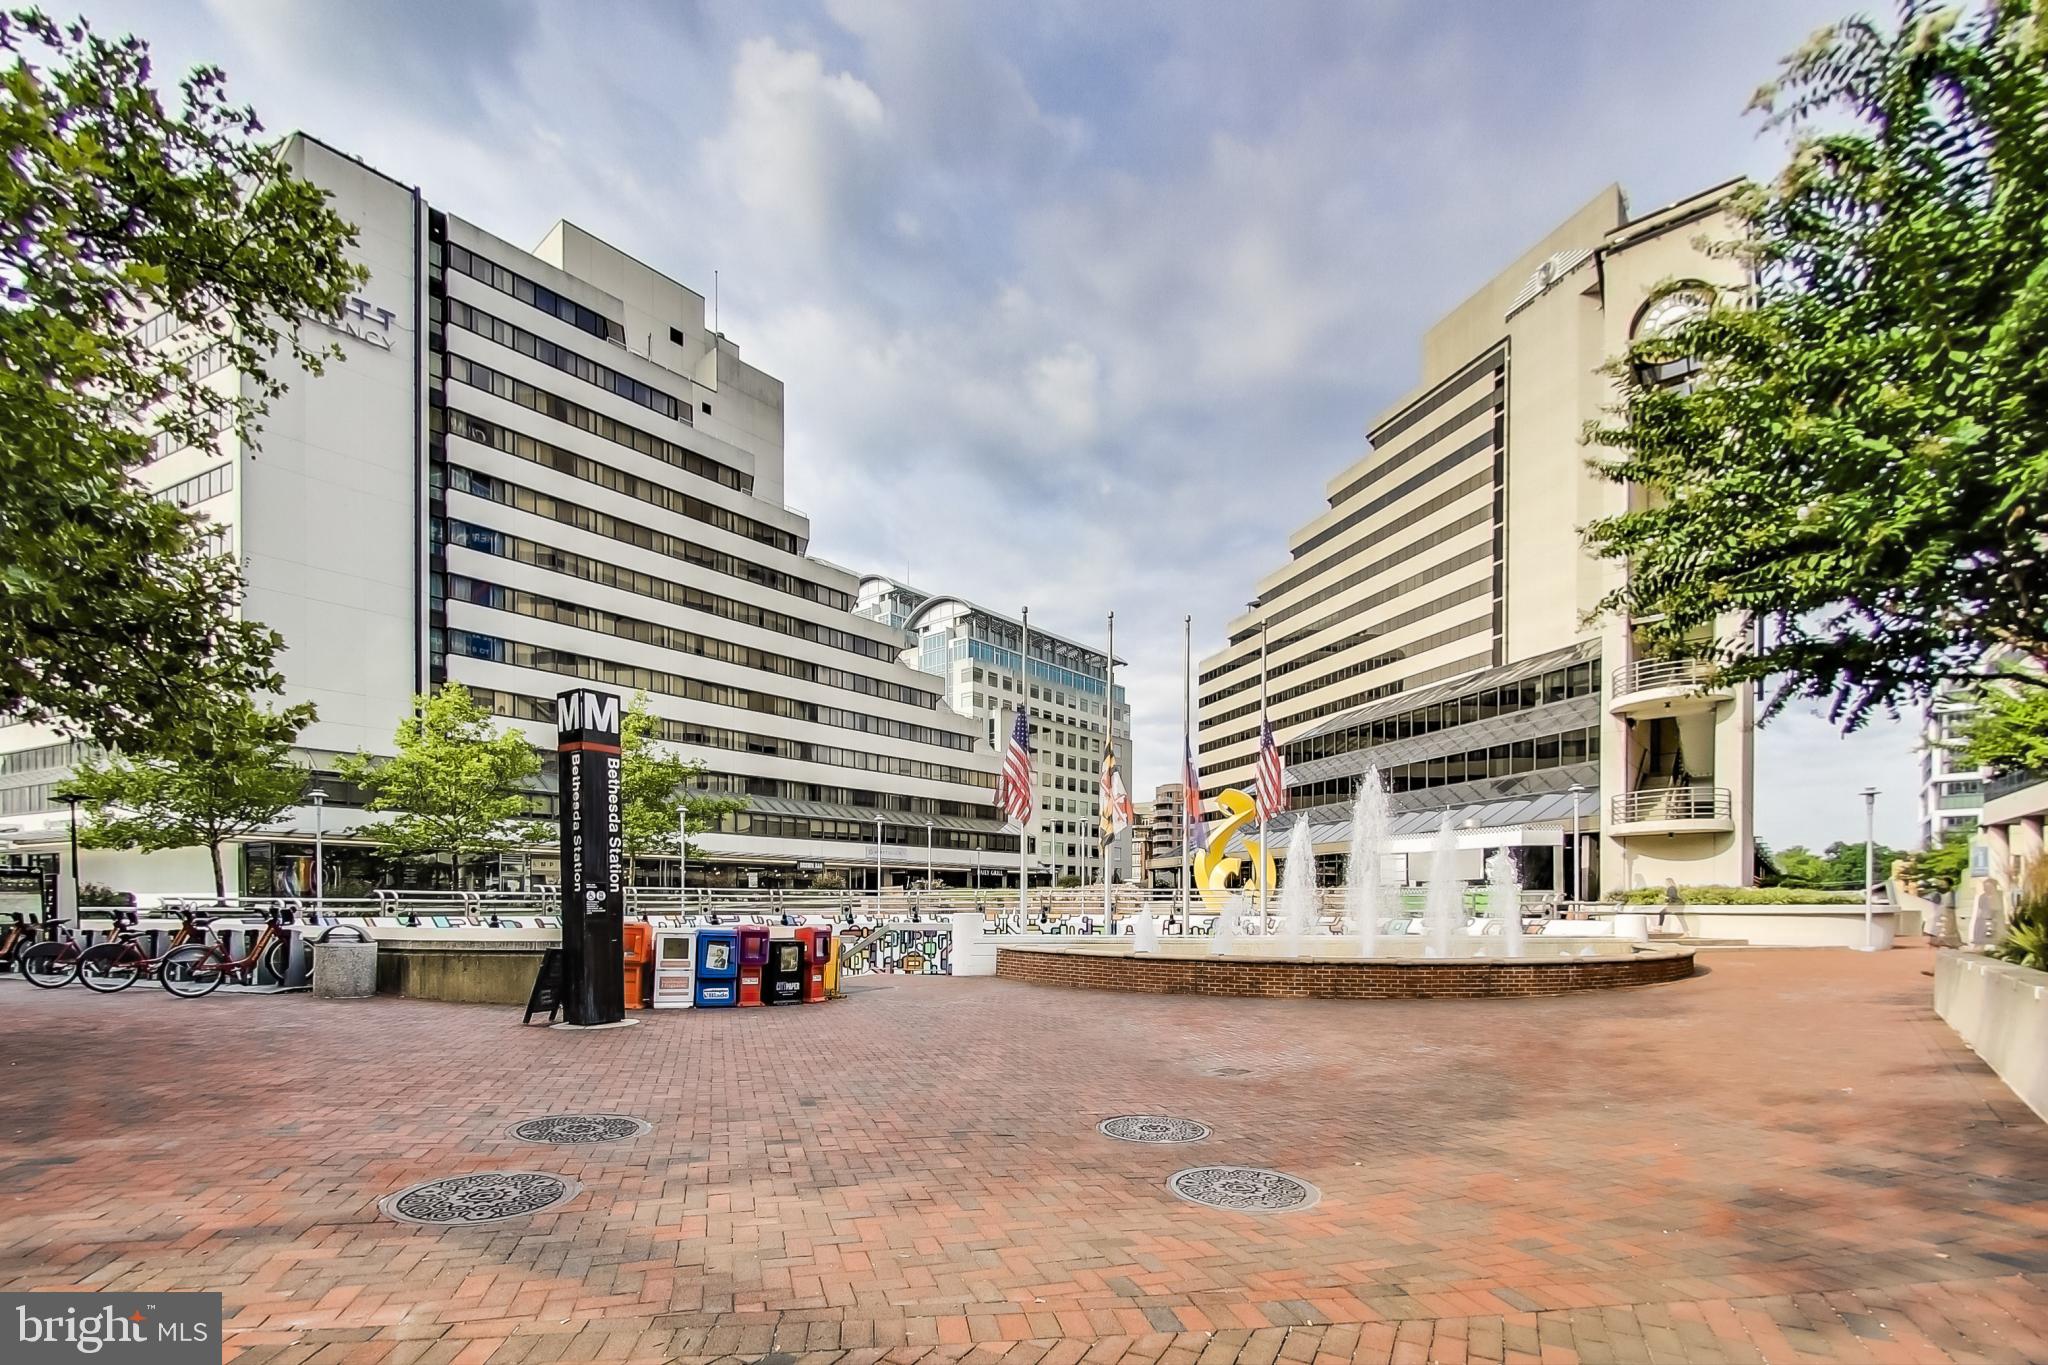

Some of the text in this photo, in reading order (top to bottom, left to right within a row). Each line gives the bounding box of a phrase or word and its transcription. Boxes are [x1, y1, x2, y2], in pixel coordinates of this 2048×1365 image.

[558, 692, 580, 733] M
[584, 692, 619, 734] M
[571, 753, 583, 892] Bethesda Station
[607, 757, 622, 893] Bethesda Station
